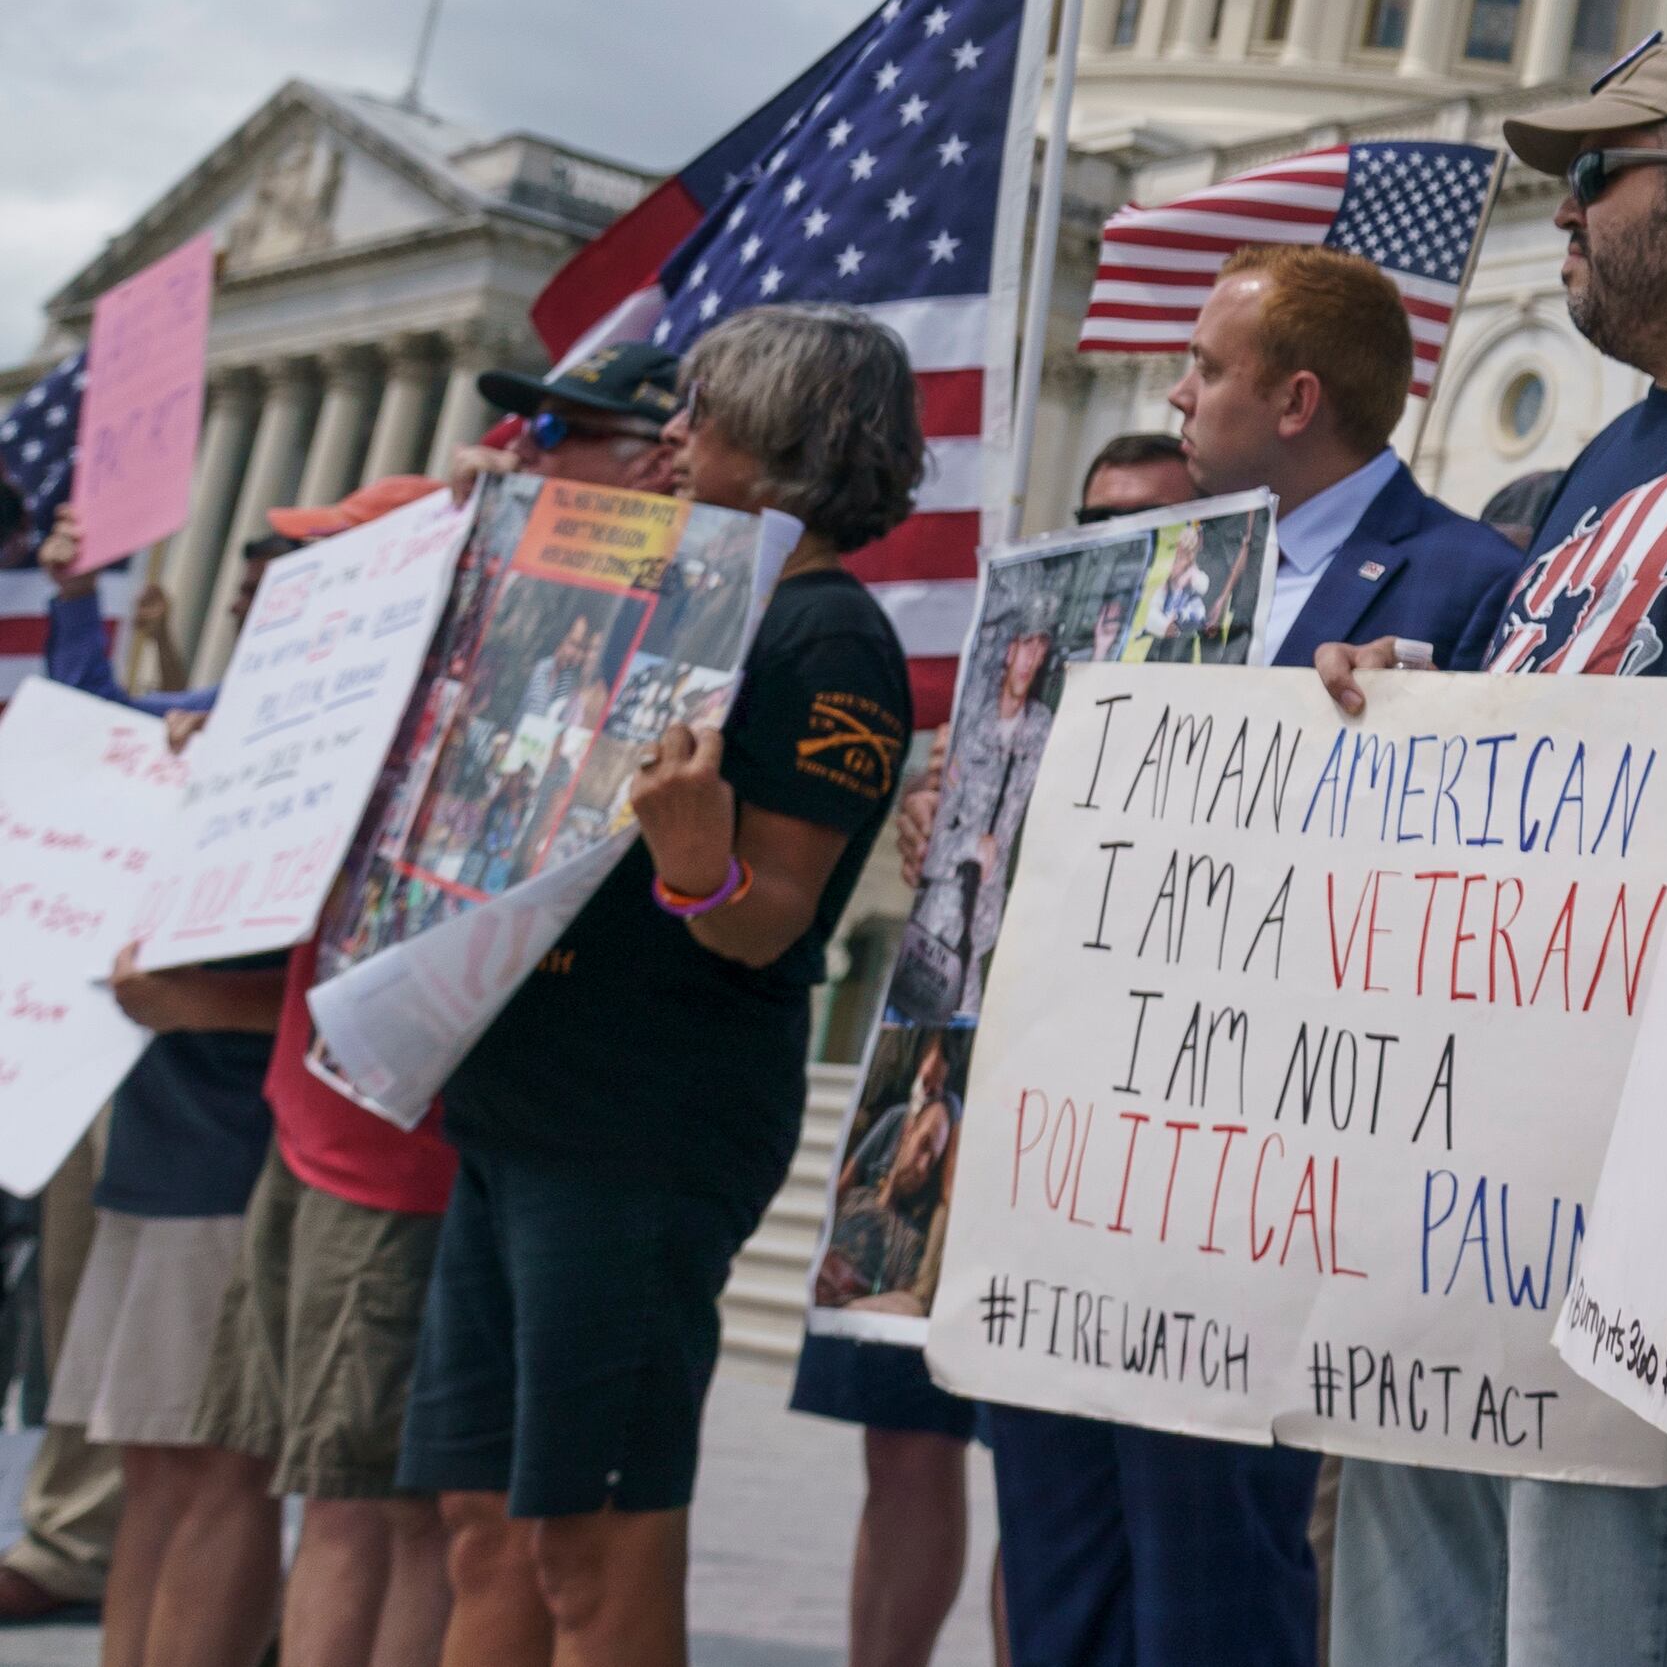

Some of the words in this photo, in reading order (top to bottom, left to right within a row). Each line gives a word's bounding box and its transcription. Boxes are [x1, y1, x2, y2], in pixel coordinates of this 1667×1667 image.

[1073, 694, 1133, 810] I
[1300, 726, 1657, 857] AMERICAN
[1082, 840, 1134, 950] I
[1137, 848, 1236, 971] AM
[1243, 864, 1295, 981] A
[1325, 868, 1667, 1016] VETERAN
[1112, 989, 1164, 1095] I
[1164, 1000, 1250, 1116] AM
[1275, 1021, 1400, 1134] NOT
[1411, 1032, 1456, 1151] A
[1010, 1087, 1369, 1278] POLITICAL
[979, 1275, 1250, 1392] #FIREWATCH
[1308, 1341, 1462, 1435] #PACT
[1471, 1374, 1560, 1451] ACT
